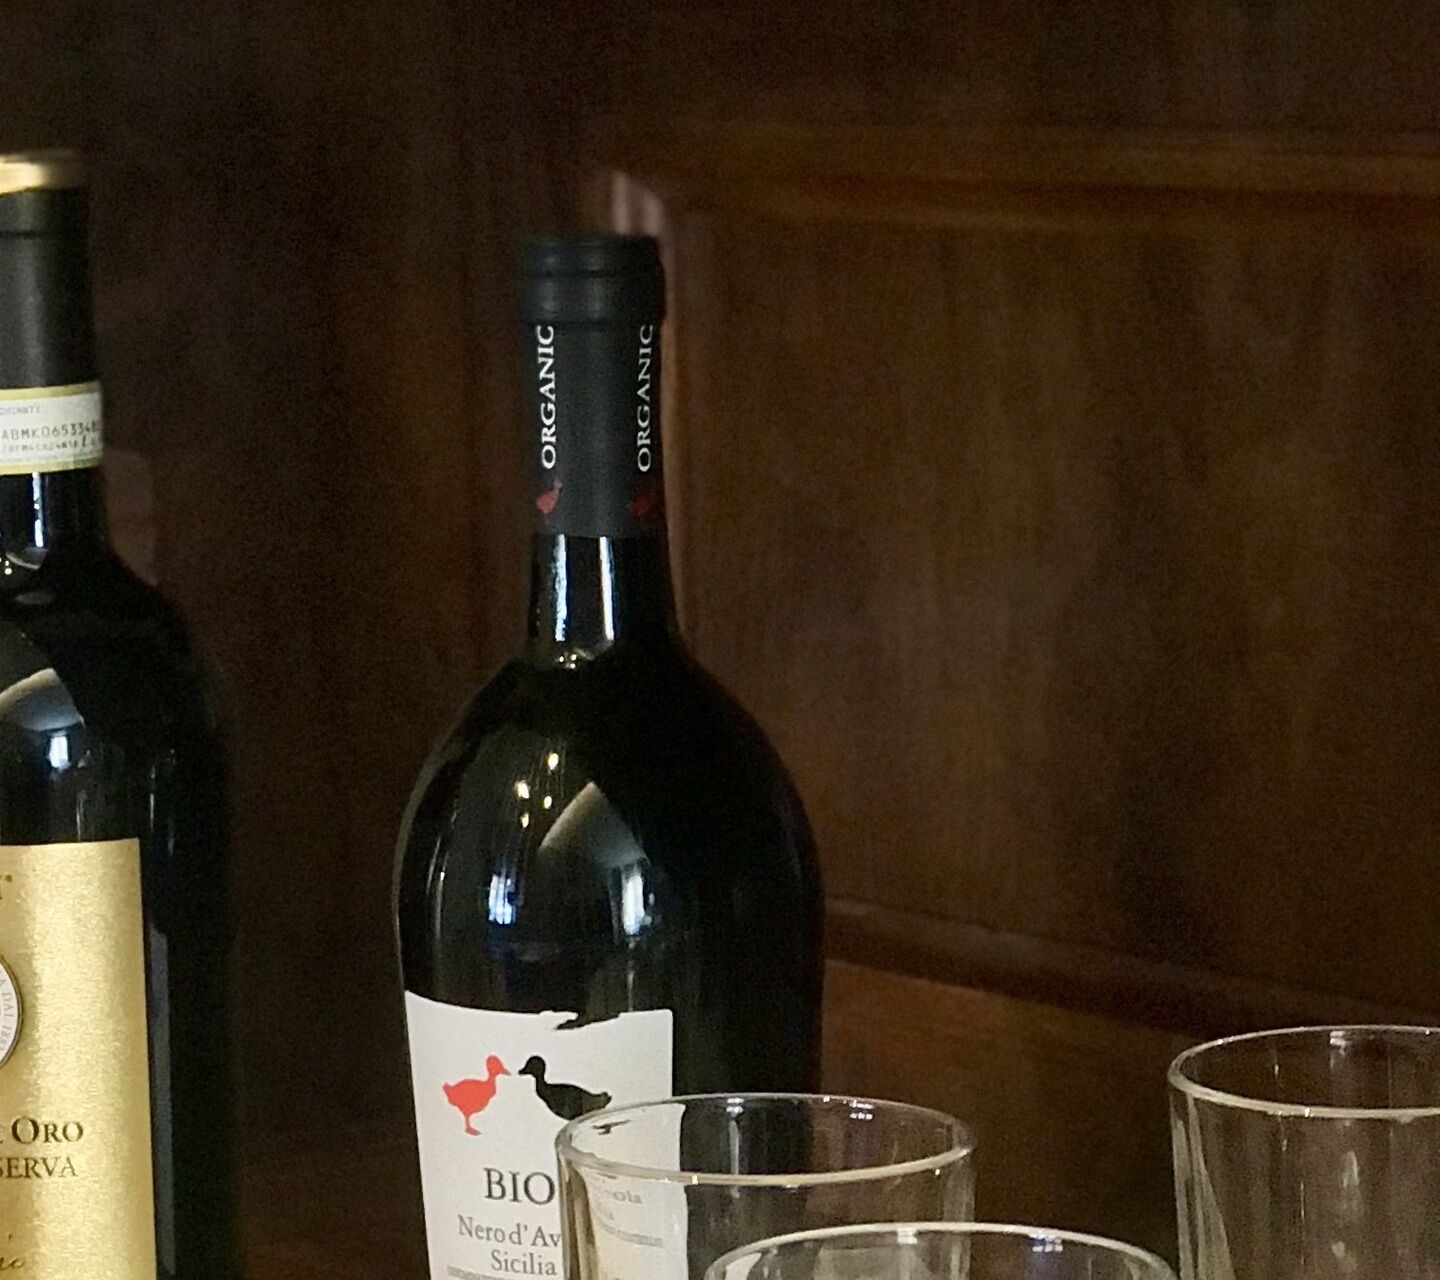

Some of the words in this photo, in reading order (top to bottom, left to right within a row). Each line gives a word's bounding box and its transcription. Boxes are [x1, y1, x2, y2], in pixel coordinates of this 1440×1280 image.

[536, 324, 557, 470] ORGANIC
[636, 324, 654, 473] ORGANIC
[11, 1115, 85, 1145] ORO
[482, 1167, 556, 1206] BIO
[457, 1213, 506, 1244] Nero
[490, 1248, 558, 1276] Sicilia
